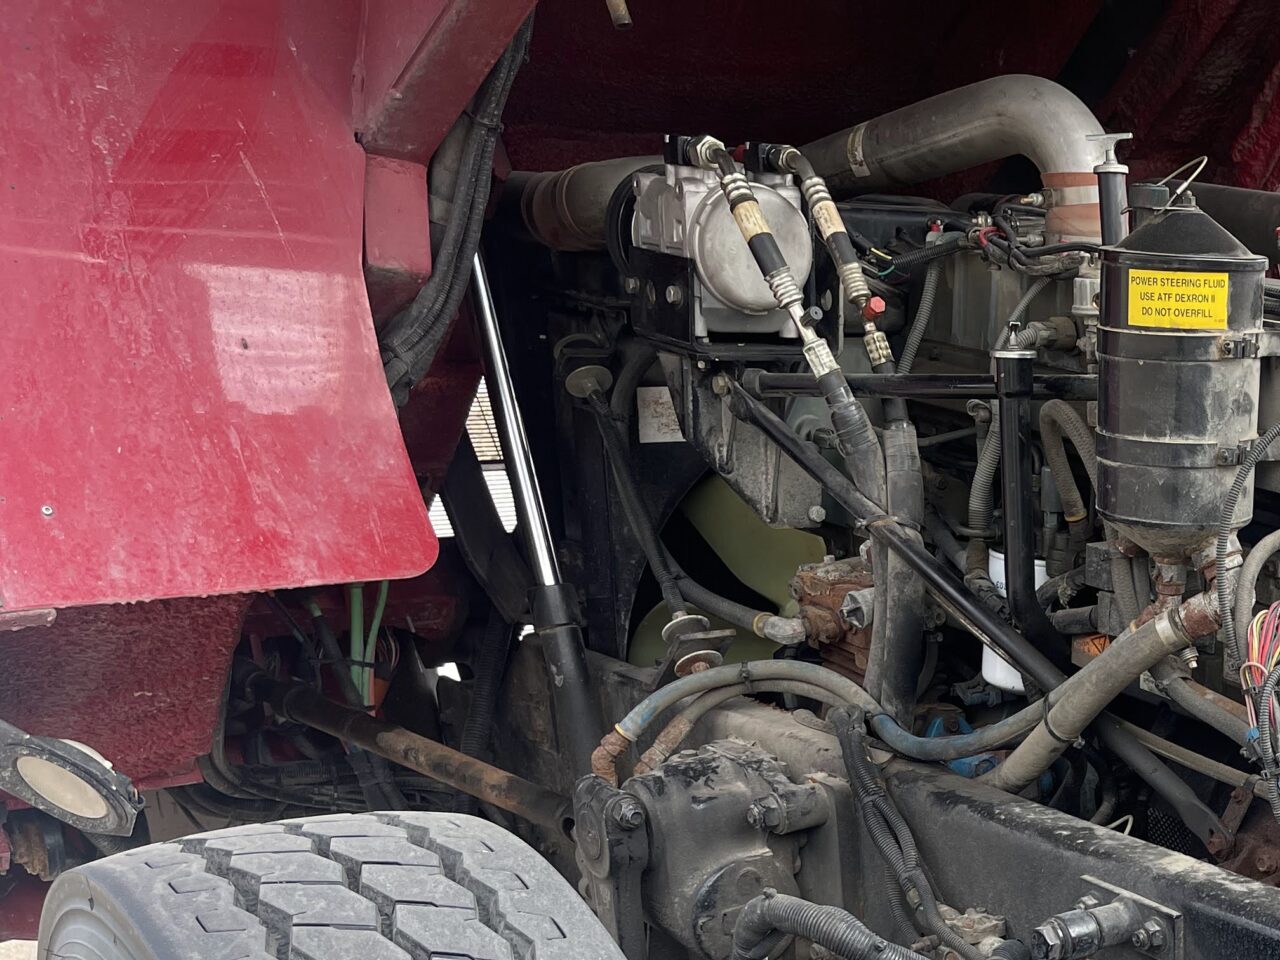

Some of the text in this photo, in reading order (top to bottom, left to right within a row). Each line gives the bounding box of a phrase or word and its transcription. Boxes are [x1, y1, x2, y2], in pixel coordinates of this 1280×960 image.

[1131, 276, 1225, 288] POWER STEERING FLUID
[1140, 292, 1155, 301] USE
[1157, 293, 1172, 302] ATF
[1175, 293, 1209, 303] DEXRON
[1142, 307, 1213, 318] DO NOT OVERFILL
